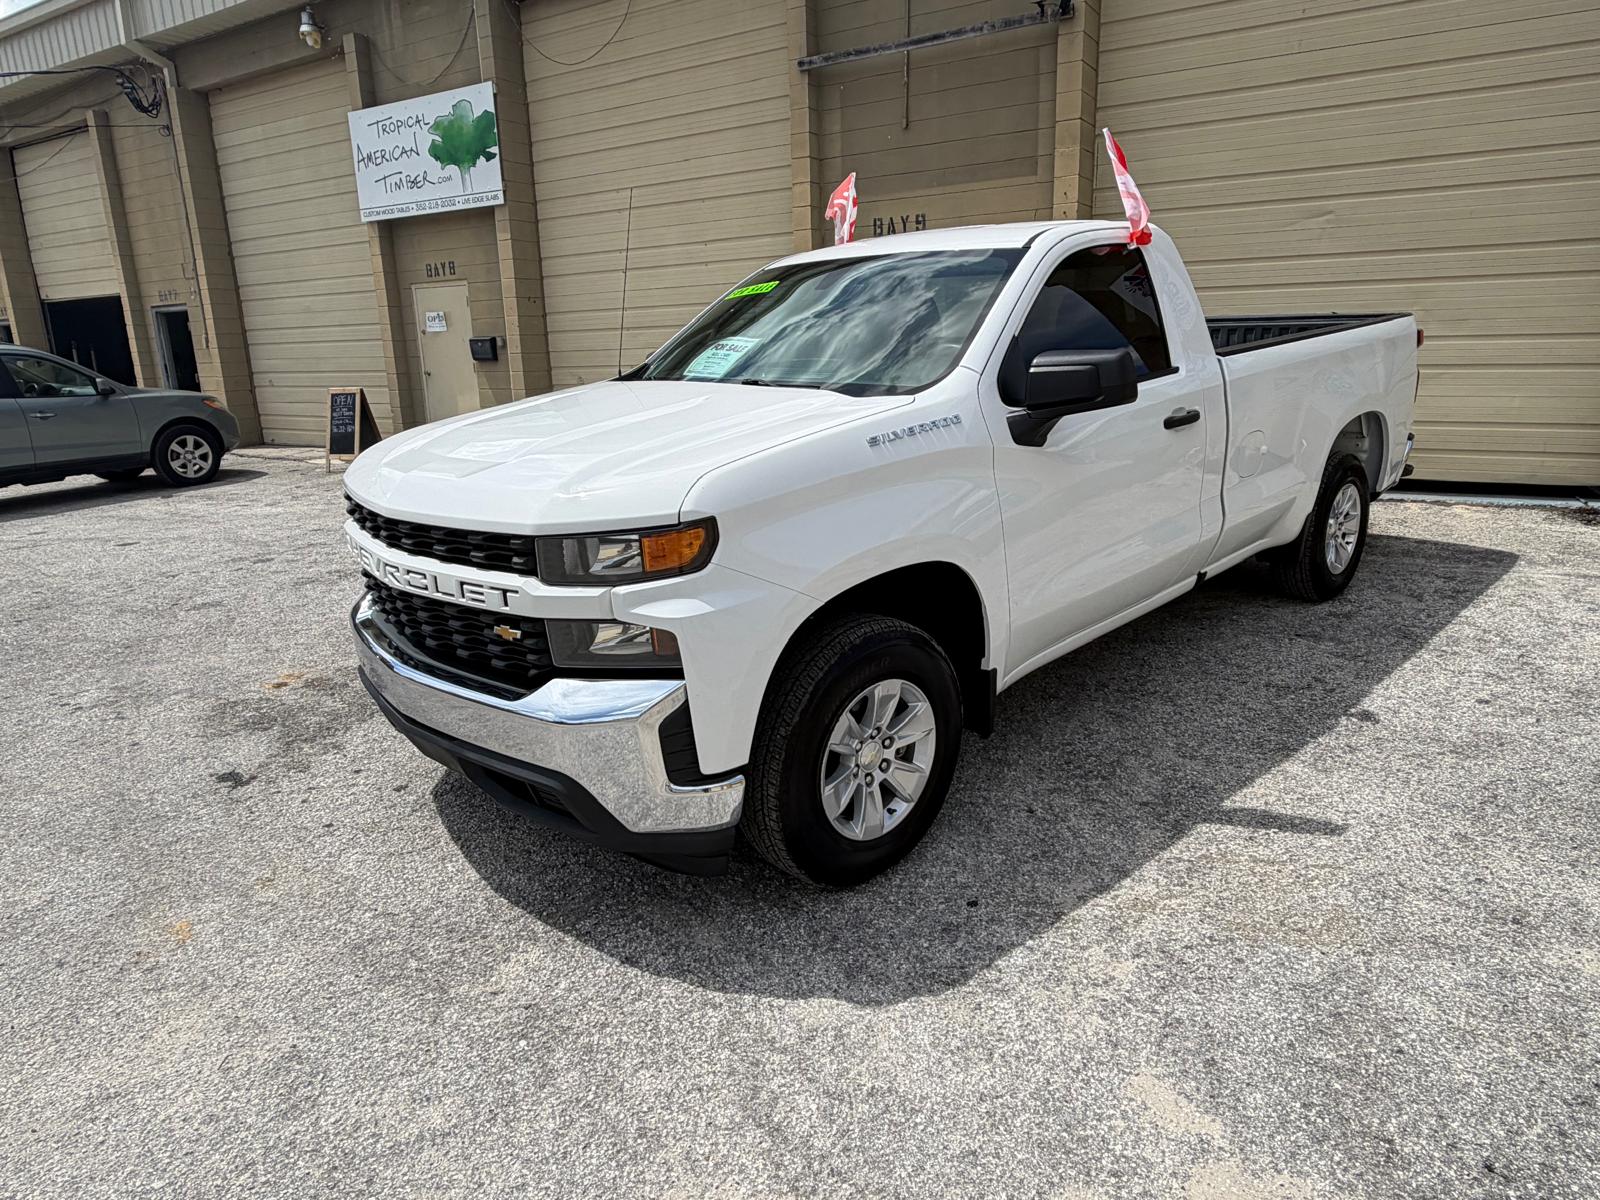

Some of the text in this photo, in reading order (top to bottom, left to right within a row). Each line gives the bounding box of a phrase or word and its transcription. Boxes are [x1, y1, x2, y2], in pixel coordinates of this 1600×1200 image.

[367, 113, 431, 138] TROPICAL
[357, 131, 420, 172] AMERICAN
[362, 210, 381, 218] CUSTOM
[396, 205, 411, 213] TABLES
[461, 197, 471, 205] LIVE
[485, 193, 500, 201] SLABS
[873, 213, 927, 237] BAY 9
[425, 261, 446, 278] BAY
[333, 394, 354, 406] OPEN
[865, 413, 962, 448] SILVERADO
[348, 536, 520, 610] HEVROLET
